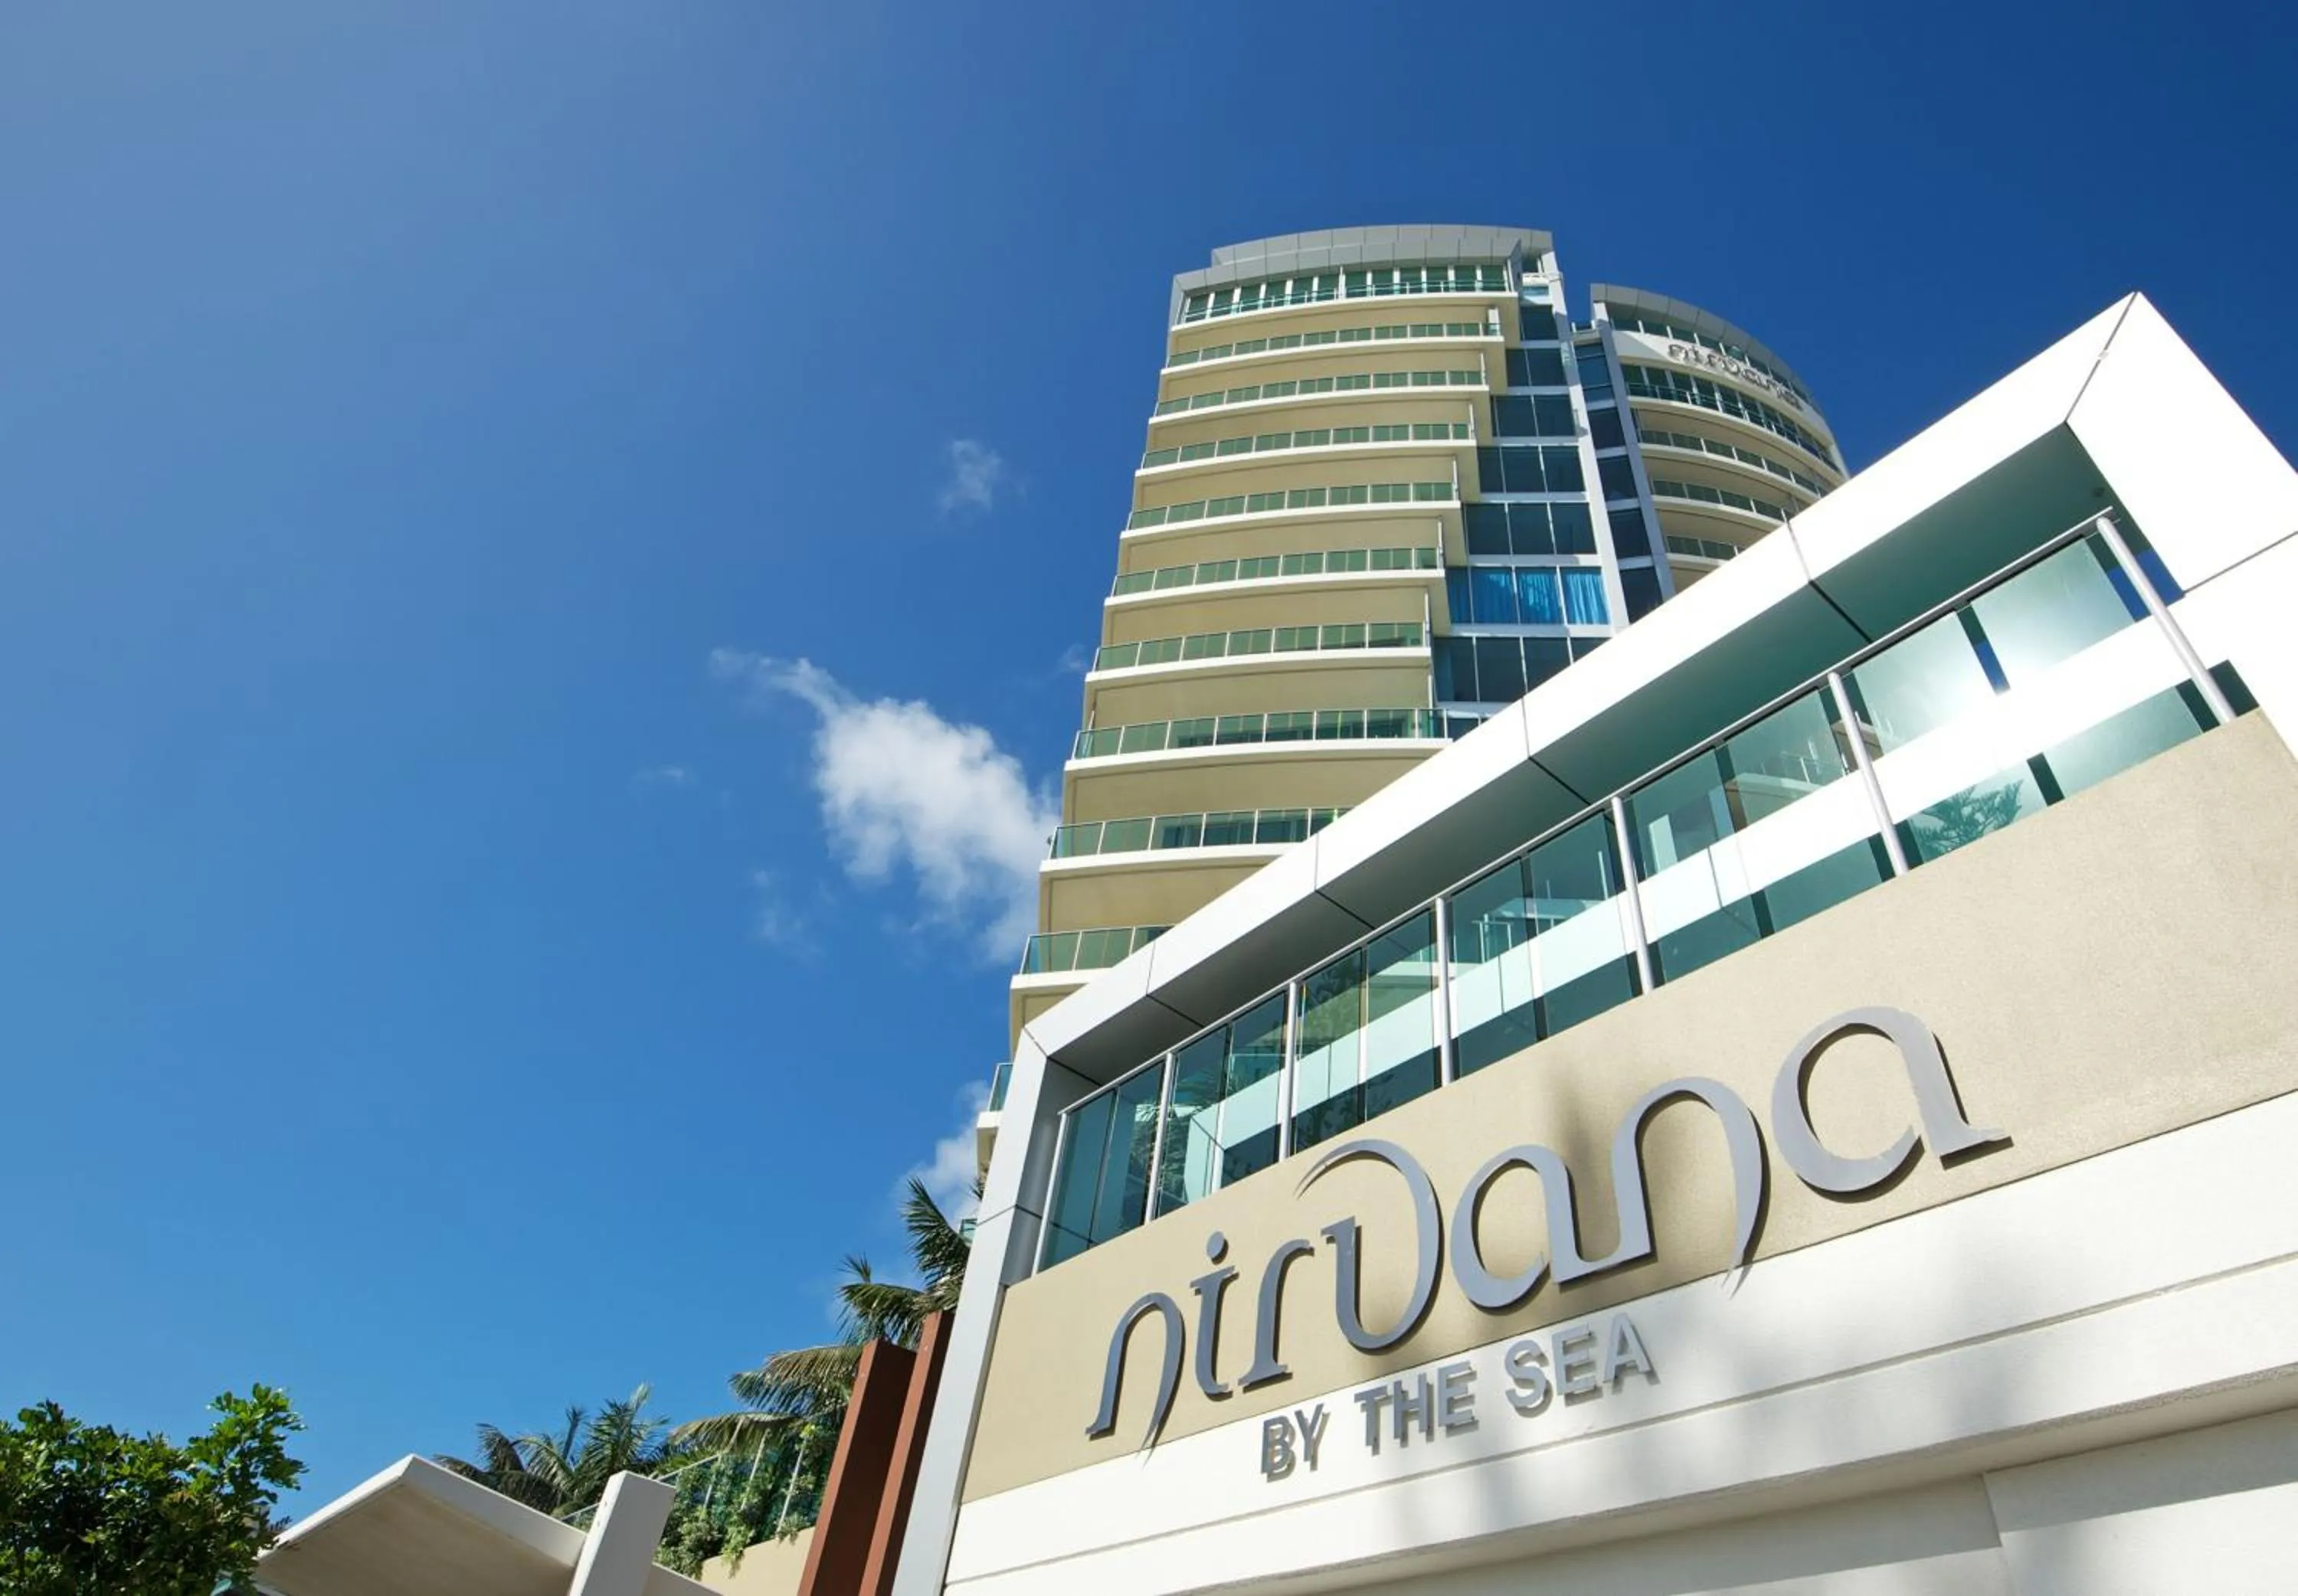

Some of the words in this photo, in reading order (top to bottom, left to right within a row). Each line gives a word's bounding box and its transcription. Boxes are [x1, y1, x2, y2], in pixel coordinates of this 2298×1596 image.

[1085, 1006, 2008, 1460] nirvana
[1261, 1395, 1324, 1475] BY
[1354, 1360, 1475, 1447] THE
[1504, 1312, 1652, 1409] SEA
